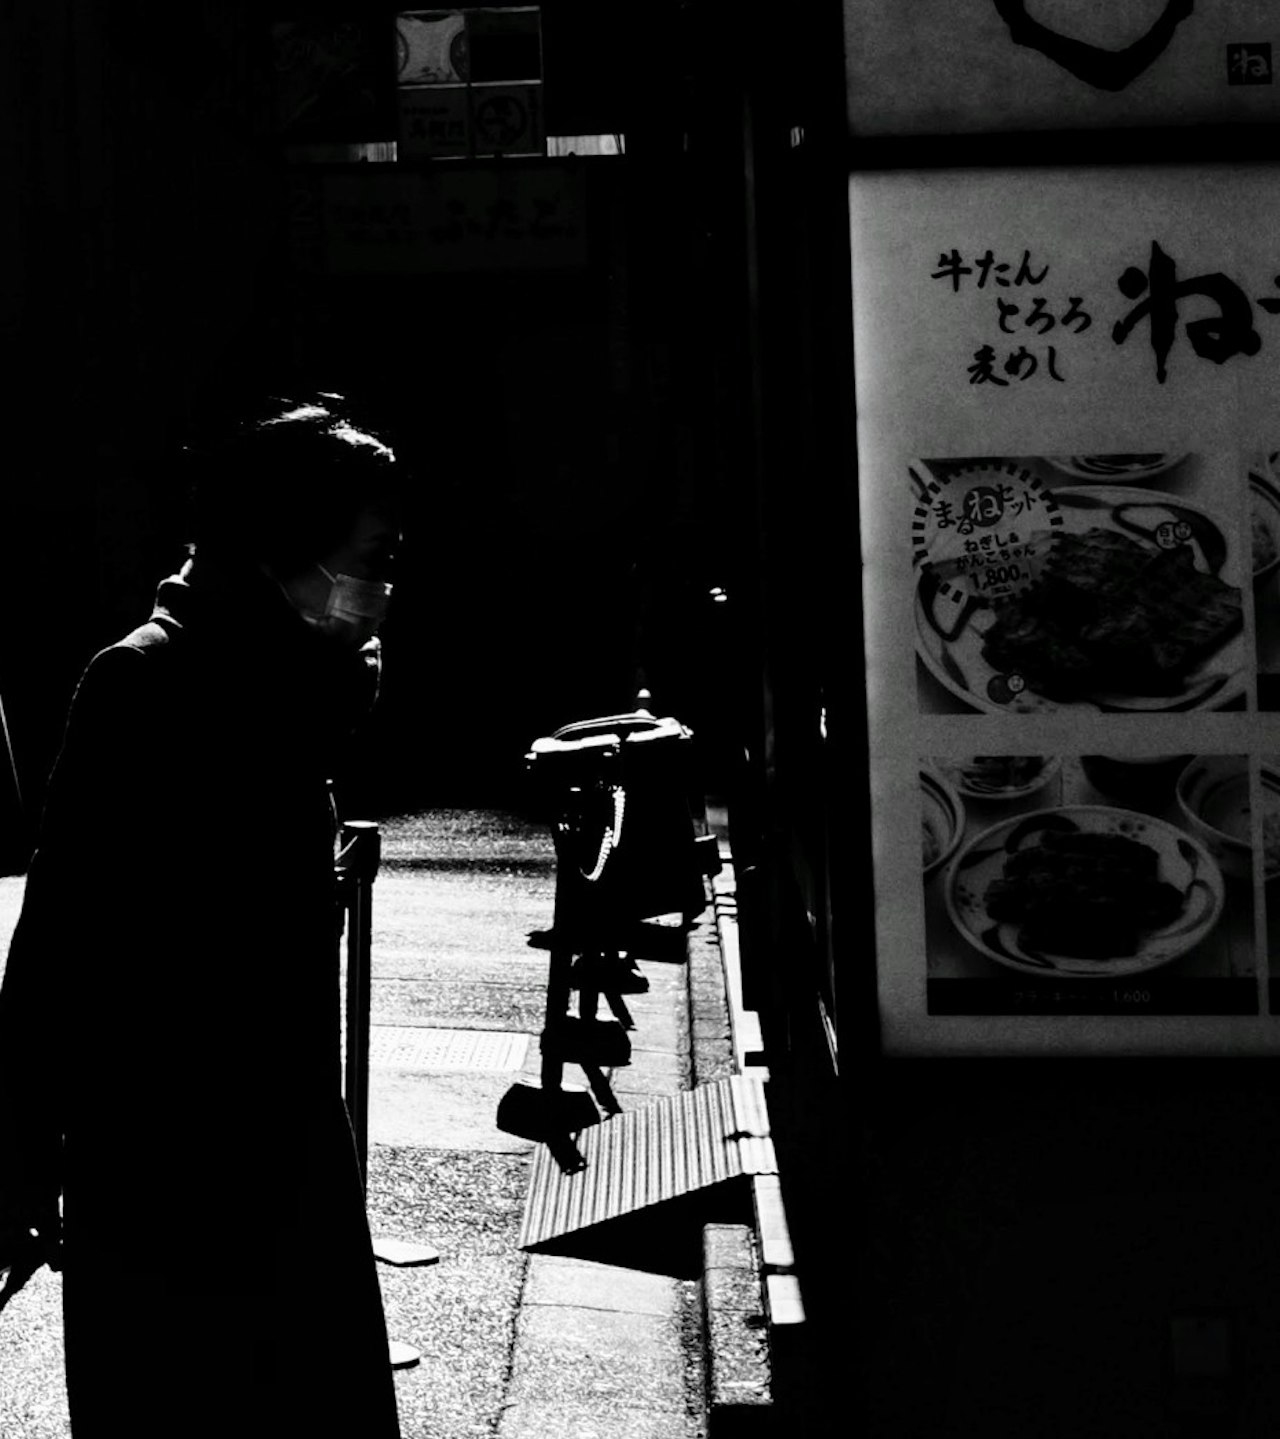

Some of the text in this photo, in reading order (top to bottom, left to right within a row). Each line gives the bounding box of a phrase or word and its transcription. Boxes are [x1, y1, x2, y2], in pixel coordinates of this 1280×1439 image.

[930, 249, 1049, 291] 牛たん
[997, 297, 1093, 334] とろろ
[1112, 240, 1280, 383] ね
[967, 345, 1067, 385] 麦めし
